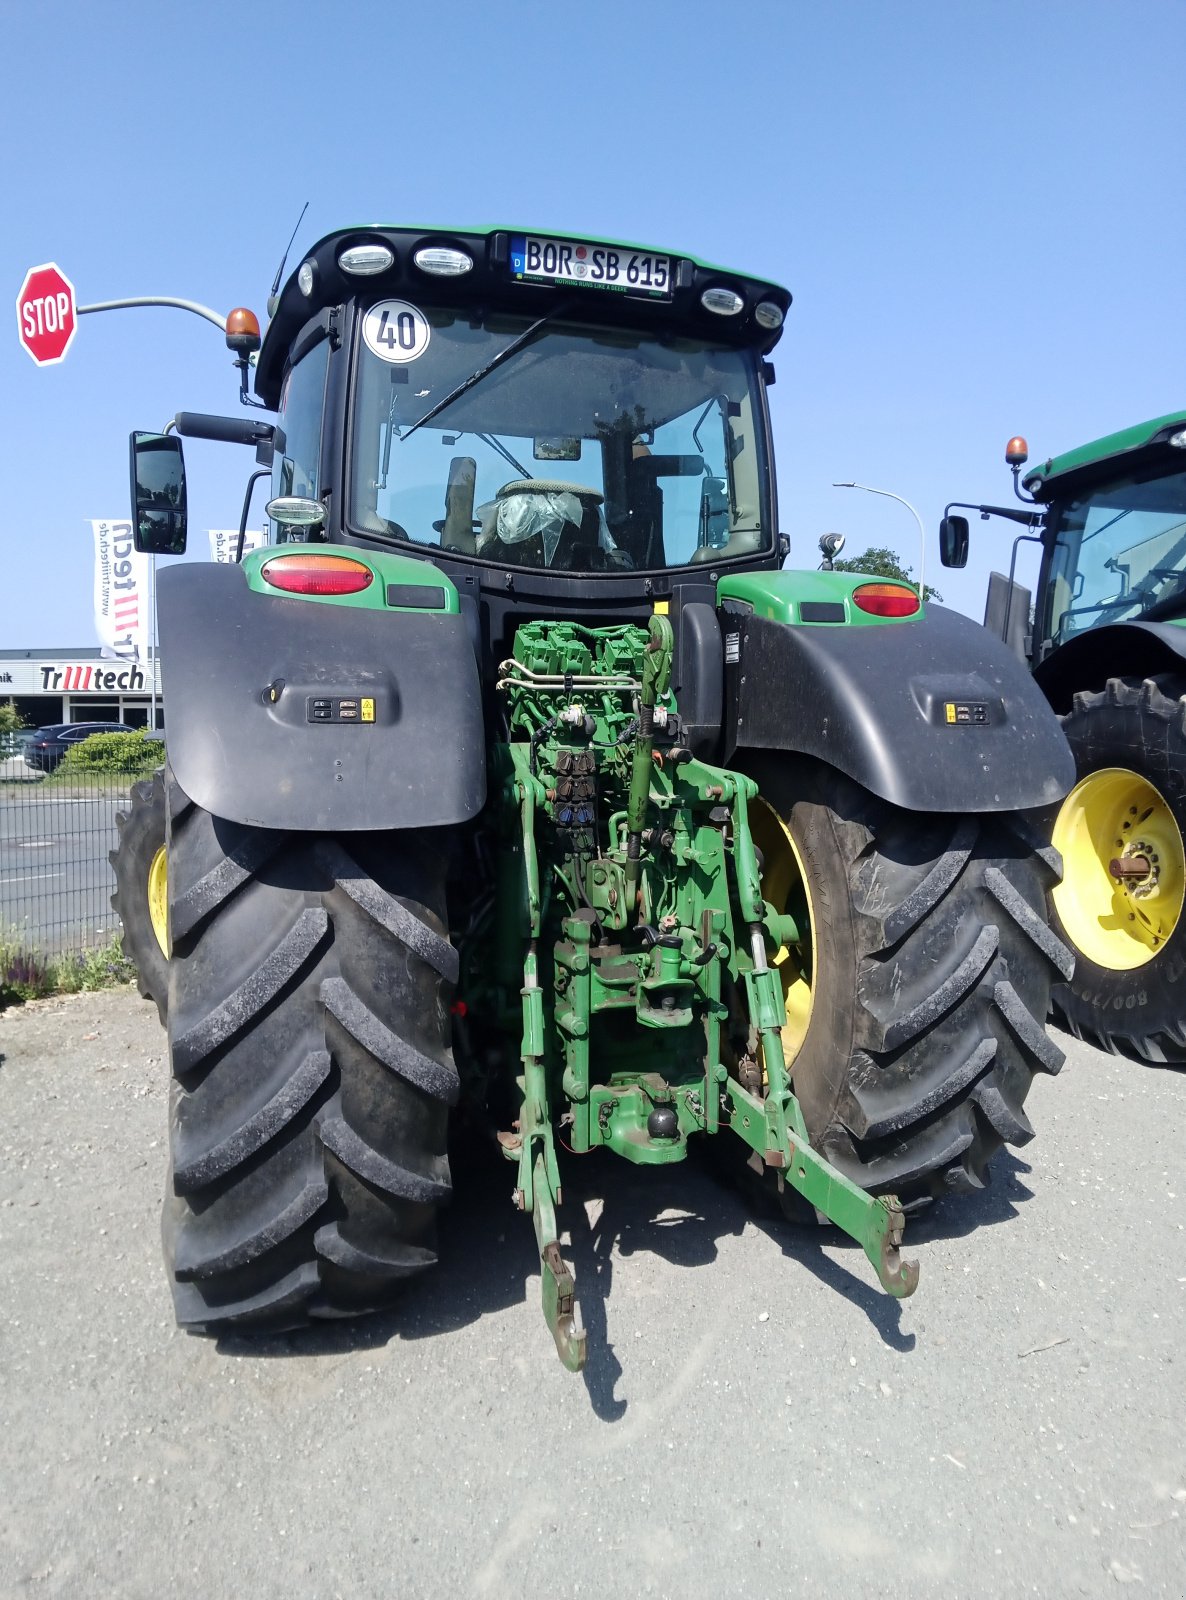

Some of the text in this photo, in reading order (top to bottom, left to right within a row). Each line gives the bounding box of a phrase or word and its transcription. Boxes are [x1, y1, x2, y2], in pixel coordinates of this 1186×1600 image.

[514, 258, 521, 267] D
[527, 241, 667, 287] BOR SB 615
[554, 278, 578, 286] NOTHING
[611, 285, 628, 293] DEERE
[22, 292, 69, 338] STOP
[376, 310, 416, 350] 40
